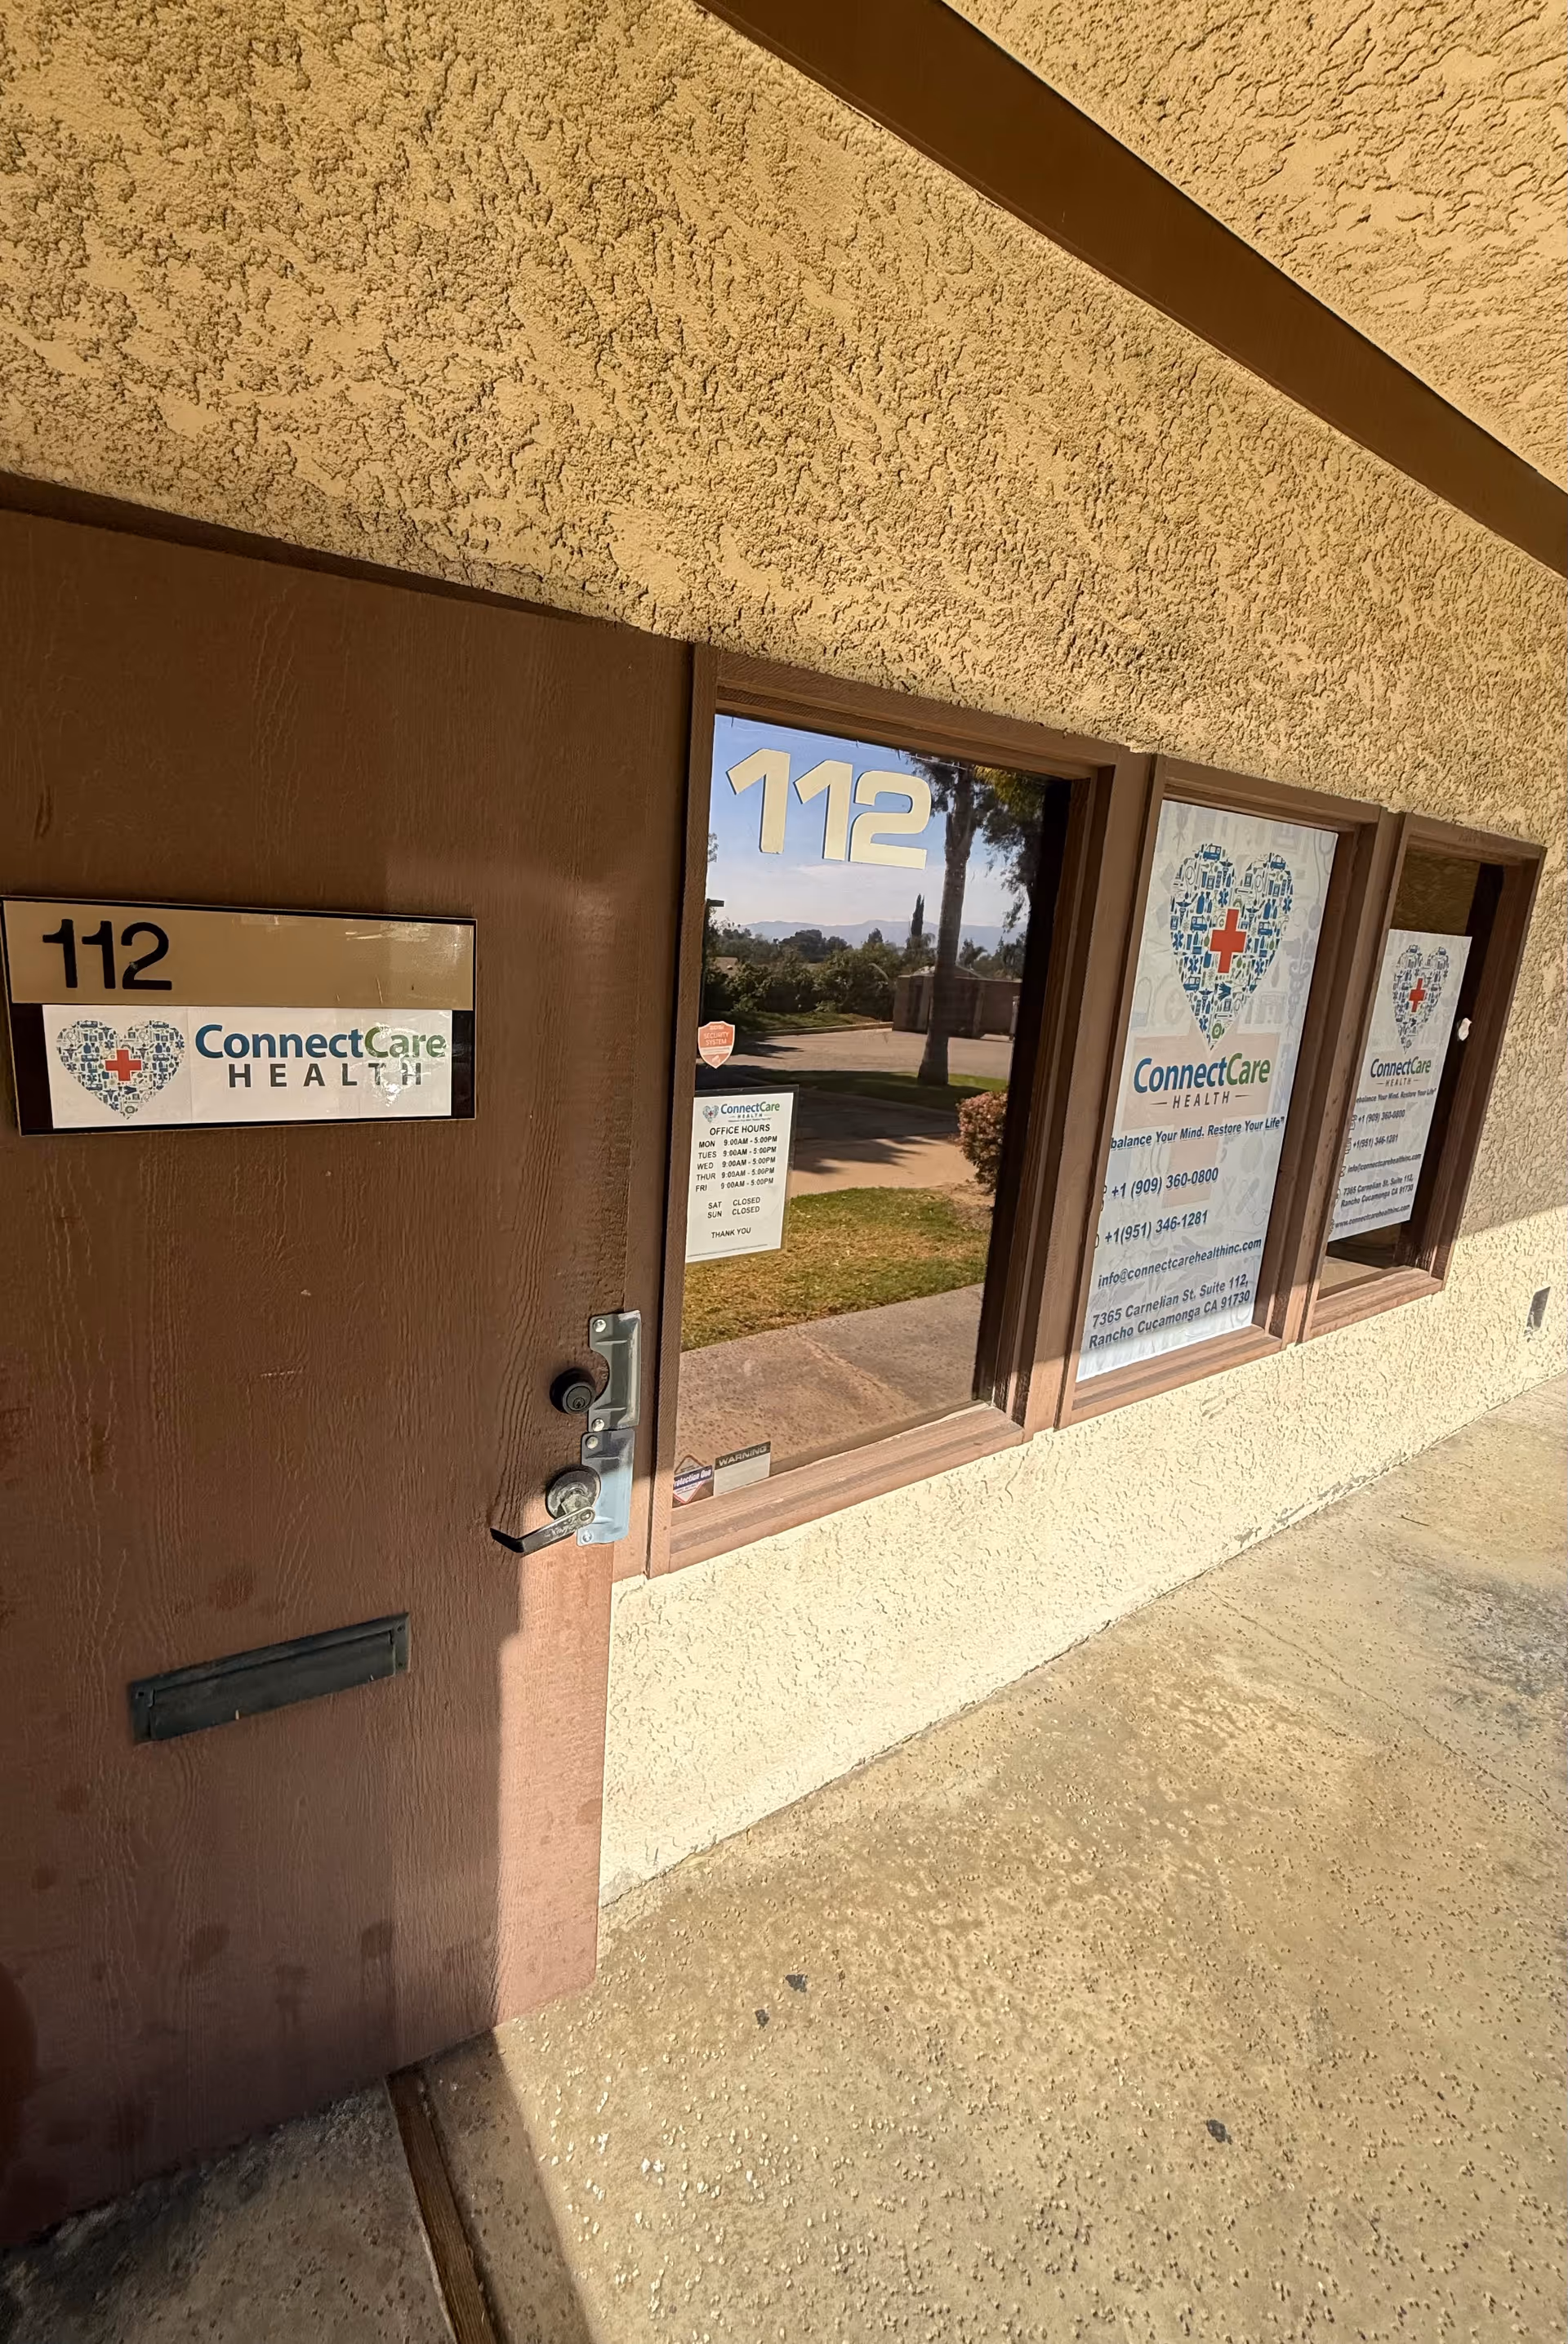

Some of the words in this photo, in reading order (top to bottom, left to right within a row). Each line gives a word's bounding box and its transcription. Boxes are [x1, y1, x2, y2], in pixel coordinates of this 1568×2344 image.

[727, 748, 932, 870] 112
[42, 919, 172, 991] 112
[194, 1023, 448, 1059] ConnectCare
[703, 1031, 729, 1039] SECURITY
[228, 1062, 422, 1088] HEALTH
[1134, 1053, 1271, 1094] ConnectCare
[1370, 1056, 1432, 1078] ConnectCare
[1385, 1077, 1411, 1087] HEALTH
[720, 1101, 781, 1114] ConnectCare
[1172, 1091, 1231, 1109] HEALTH
[1358, 1114, 1365, 1124] +1
[1365, 1112, 1380, 1124] (909)
[709, 1125, 739, 1136] OFFICE
[742, 1123, 771, 1134] HOURS
[1156, 1130, 1178, 1143] Your
[1179, 1125, 1205, 1139] Mind.
[1207, 1122, 1241, 1136] Restore
[1245, 1118, 1263, 1131] Your
[698, 1140, 715, 1148] MON
[724, 1138, 748, 1146] 9:00AM
[754, 1135, 777, 1143] 5:00PM
[1374, 1134, 1398, 1146] 346-1281
[698, 1151, 717, 1159] TUES
[723, 1148, 747, 1156] 9:00AM
[753, 1146, 777, 1154] 5:00PM
[697, 1161, 714, 1170] WED
[722, 1159, 746, 1167] 9:00AM
[752, 1156, 776, 1165] 5:00PM
[697, 1173, 716, 1181] THUR
[721, 1170, 746, 1179] 9:00AM
[751, 1167, 775, 1175] 5:00PM
[720, 1180, 745, 1189] 9:00AM
[751, 1178, 773, 1186] 5:00PM
[1111, 1183, 1126, 1197] +1
[1130, 1176, 1162, 1199] (909)
[1165, 1167, 1218, 1189] 360-0800
[1341, 1197, 1361, 1209] Rancho
[1361, 1190, 1390, 1204] Cucamonga
[1391, 1188, 1398, 1196] CA
[1399, 1183, 1414, 1194] 91730
[1343, 1186, 1356, 1196] 7365
[1357, 1181, 1382, 1193] Carnelian
[1390, 1176, 1403, 1186] Suite
[707, 1201, 722, 1210] SAT
[733, 1197, 760, 1206] CLOSED
[732, 1206, 760, 1215] CLOSED
[1335, 1204, 1410, 1229] www.connectcarehealthinc.com
[710, 1229, 735, 1238] THANK
[1105, 1221, 1152, 1245] +1(951)
[1155, 1210, 1208, 1234] 346-1281
[1098, 1238, 1262, 1288] info@connectcarehealthinc.com
[1093, 1312, 1121, 1328] 7365
[1125, 1295, 1178, 1318] Carnelian
[1200, 1283, 1226, 1298] Suite
[1229, 1273, 1249, 1288] 112,
[1089, 1326, 1134, 1348] Rancho
[1137, 1306, 1200, 1334] Cucamonga
[1204, 1299, 1218, 1312] CA
[1220, 1290, 1250, 1308] 91730
[718, 1446, 767, 1467] WARNING
